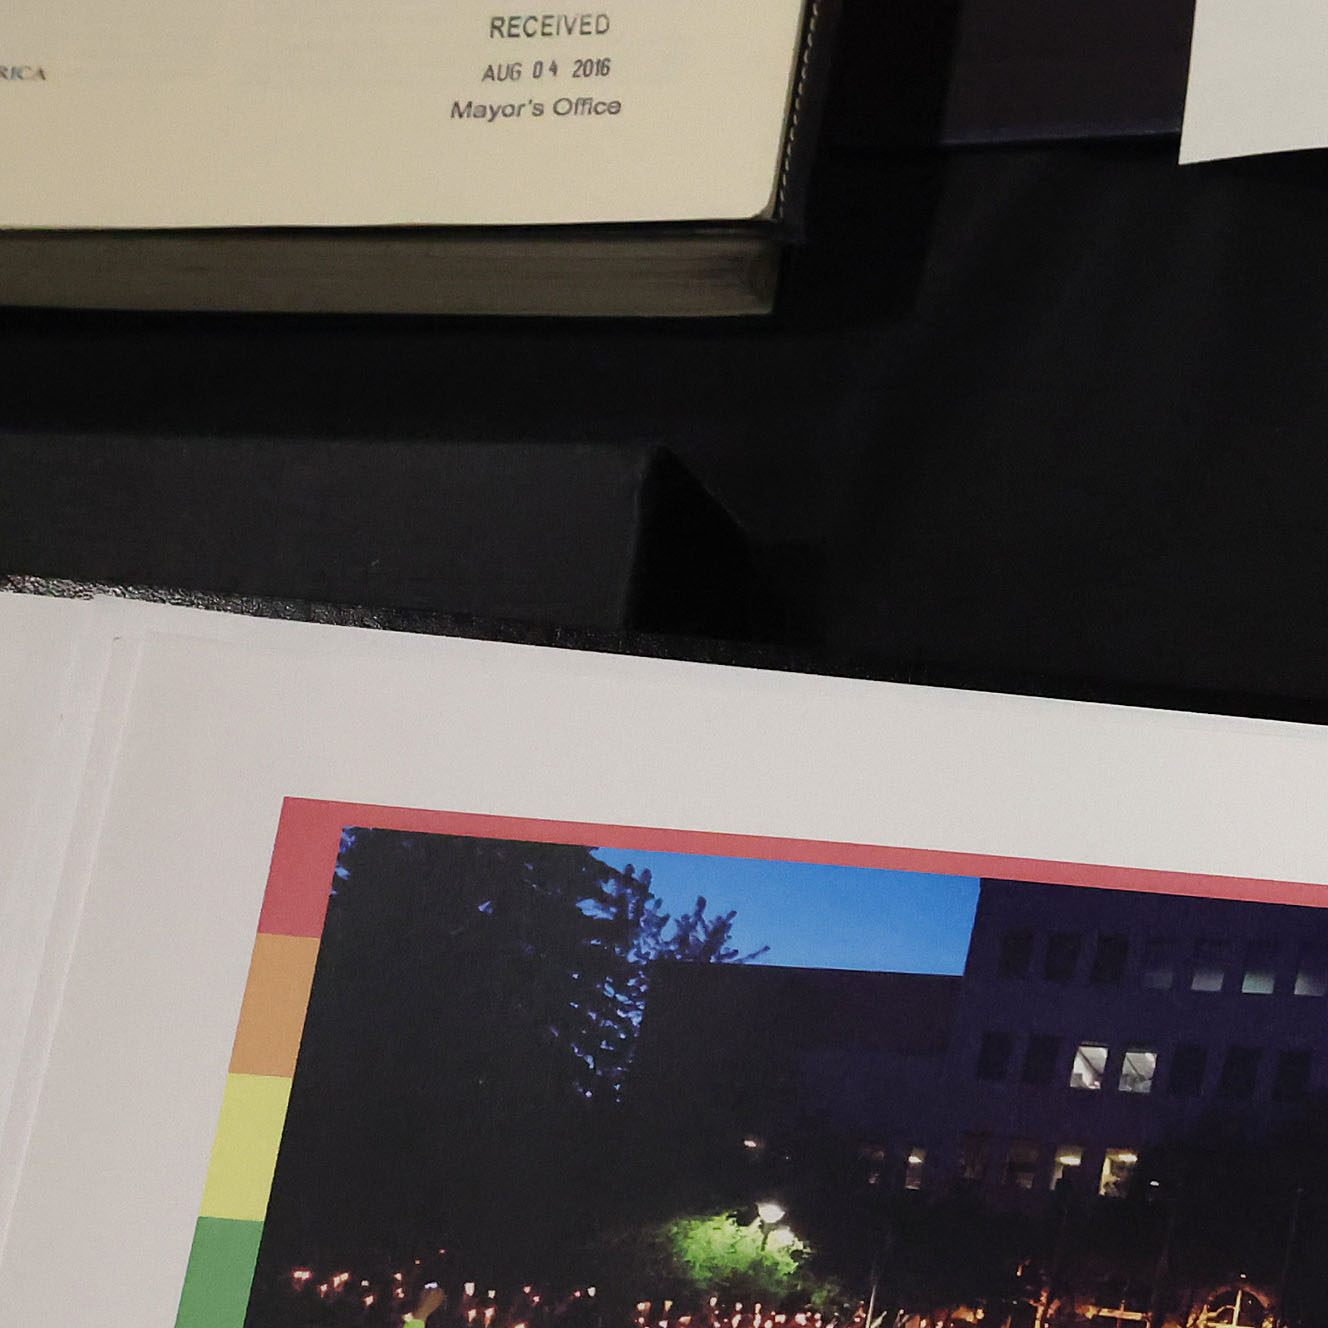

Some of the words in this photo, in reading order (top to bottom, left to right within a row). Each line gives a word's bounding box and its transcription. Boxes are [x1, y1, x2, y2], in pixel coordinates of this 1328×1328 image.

[489, 13, 611, 39] RECEIVED
[481, 61, 523, 82] AUG
[571, 57, 612, 78] 2016
[449, 99, 545, 123] Mayor's
[552, 97, 623, 116] Office
